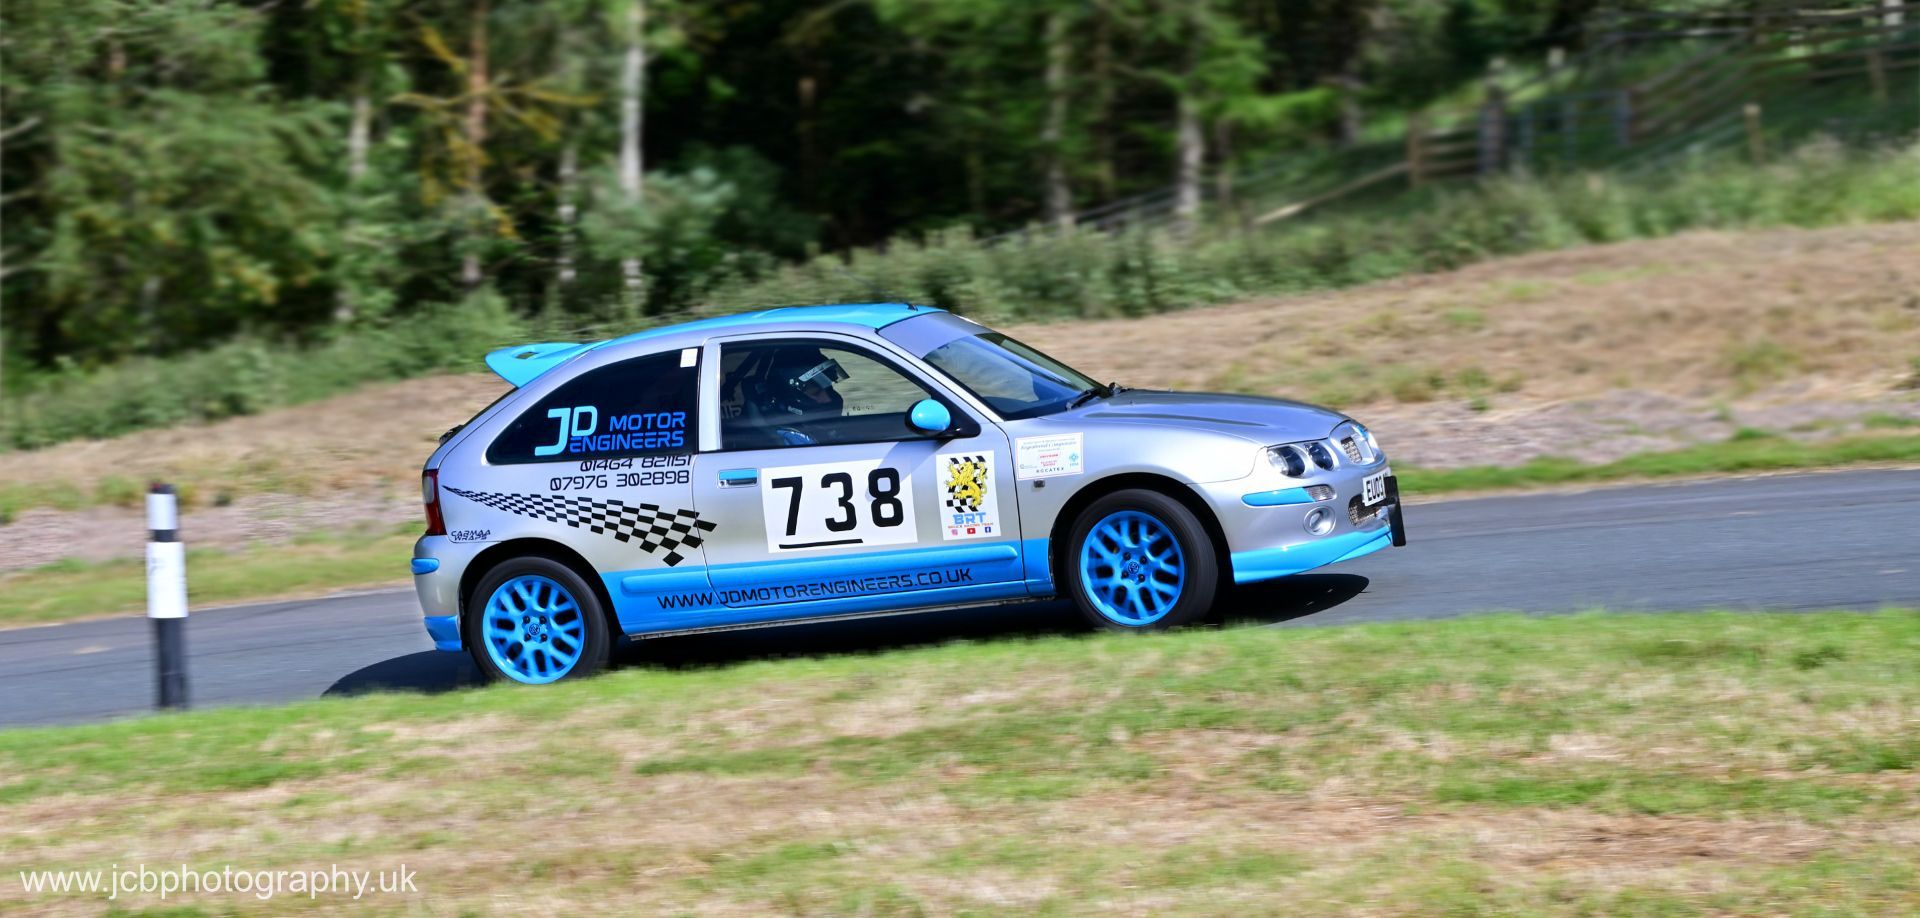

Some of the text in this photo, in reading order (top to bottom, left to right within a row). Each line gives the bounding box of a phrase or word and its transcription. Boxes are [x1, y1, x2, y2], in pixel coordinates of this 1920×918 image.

[535, 405, 598, 456] JD
[609, 411, 686, 432] MOTOR
[569, 430, 685, 453] ENGINEERS
[550, 470, 690, 491] 07976 302898
[771, 467, 904, 536] 738
[952, 512, 986, 524] BRT
[657, 568, 973, 609] WWW.JDMOTORENGINEERS.CO.UK
